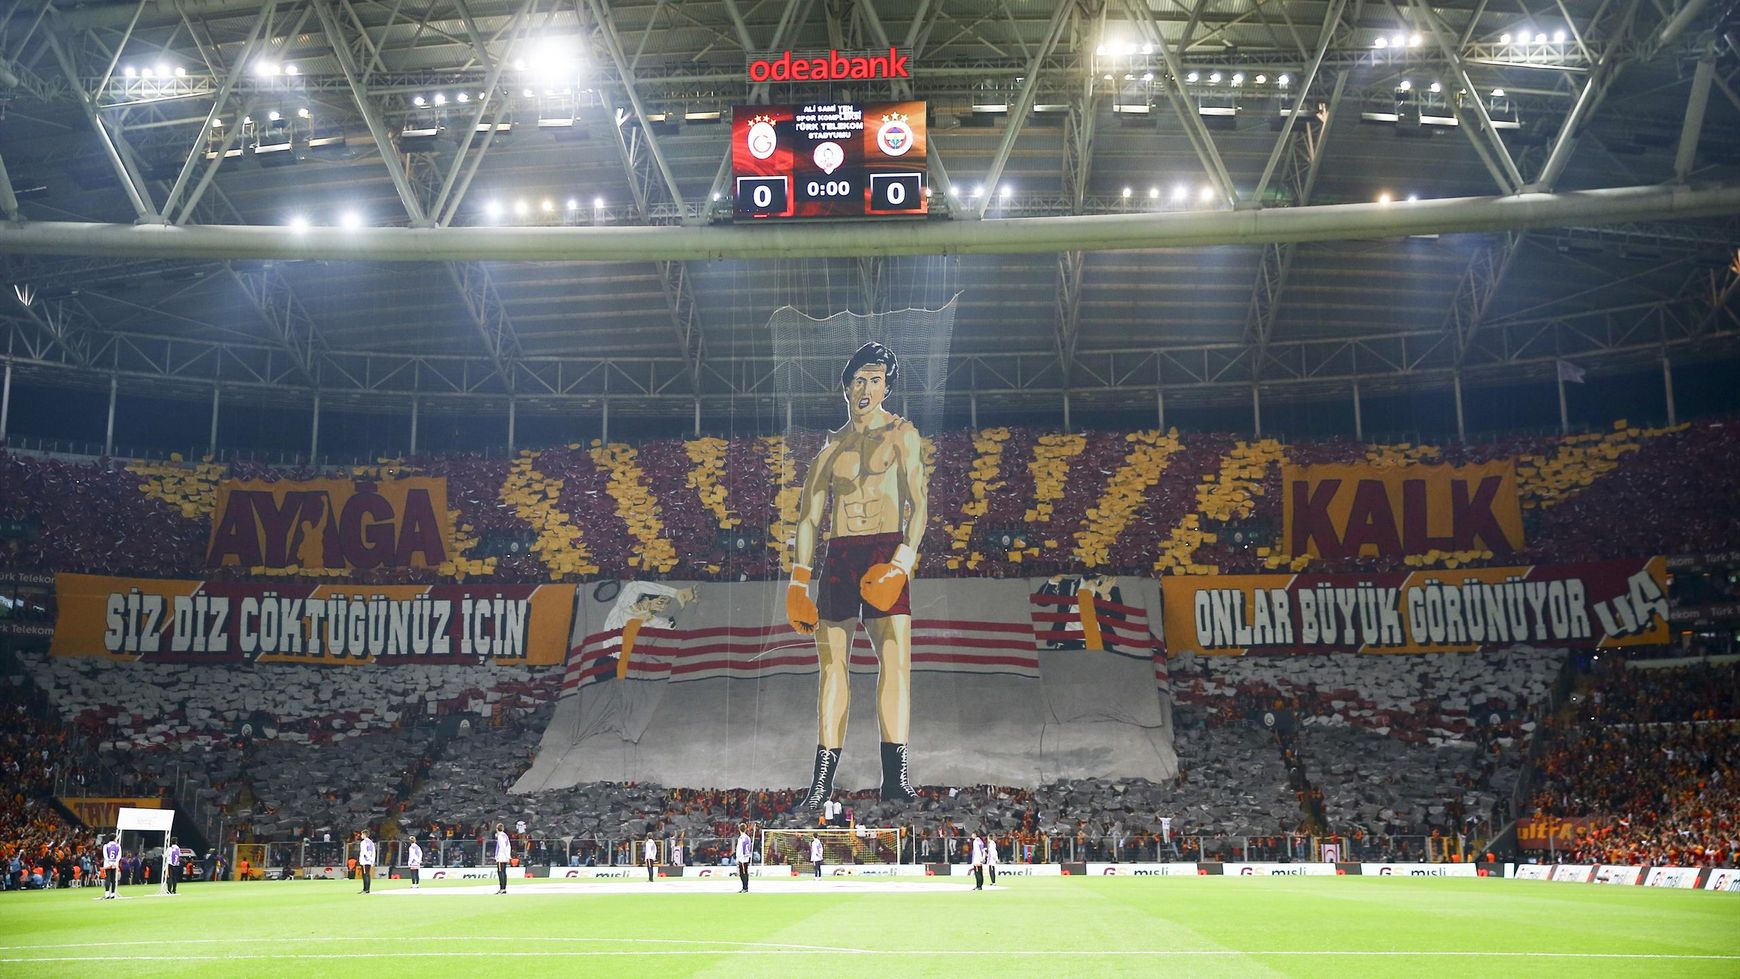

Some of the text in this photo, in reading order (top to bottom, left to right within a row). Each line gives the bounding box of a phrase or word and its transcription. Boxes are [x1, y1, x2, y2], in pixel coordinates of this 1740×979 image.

[750, 47, 908, 82] odeabank
[821, 122, 863, 130] TELEKOM
[753, 186, 772, 207] 0
[807, 181, 850, 196] 0:00
[886, 183, 906, 204] 0
[1291, 476, 1515, 560] KALK
[1195, 577, 1591, 646] ONLAR BÜYÜK GÖRÜNÜYOR
[12, 624, 54, 635] Telekom
[105, 588, 527, 660] SİZ DİZ ÇÖKTÜĞÜNÜZ İÇİN
